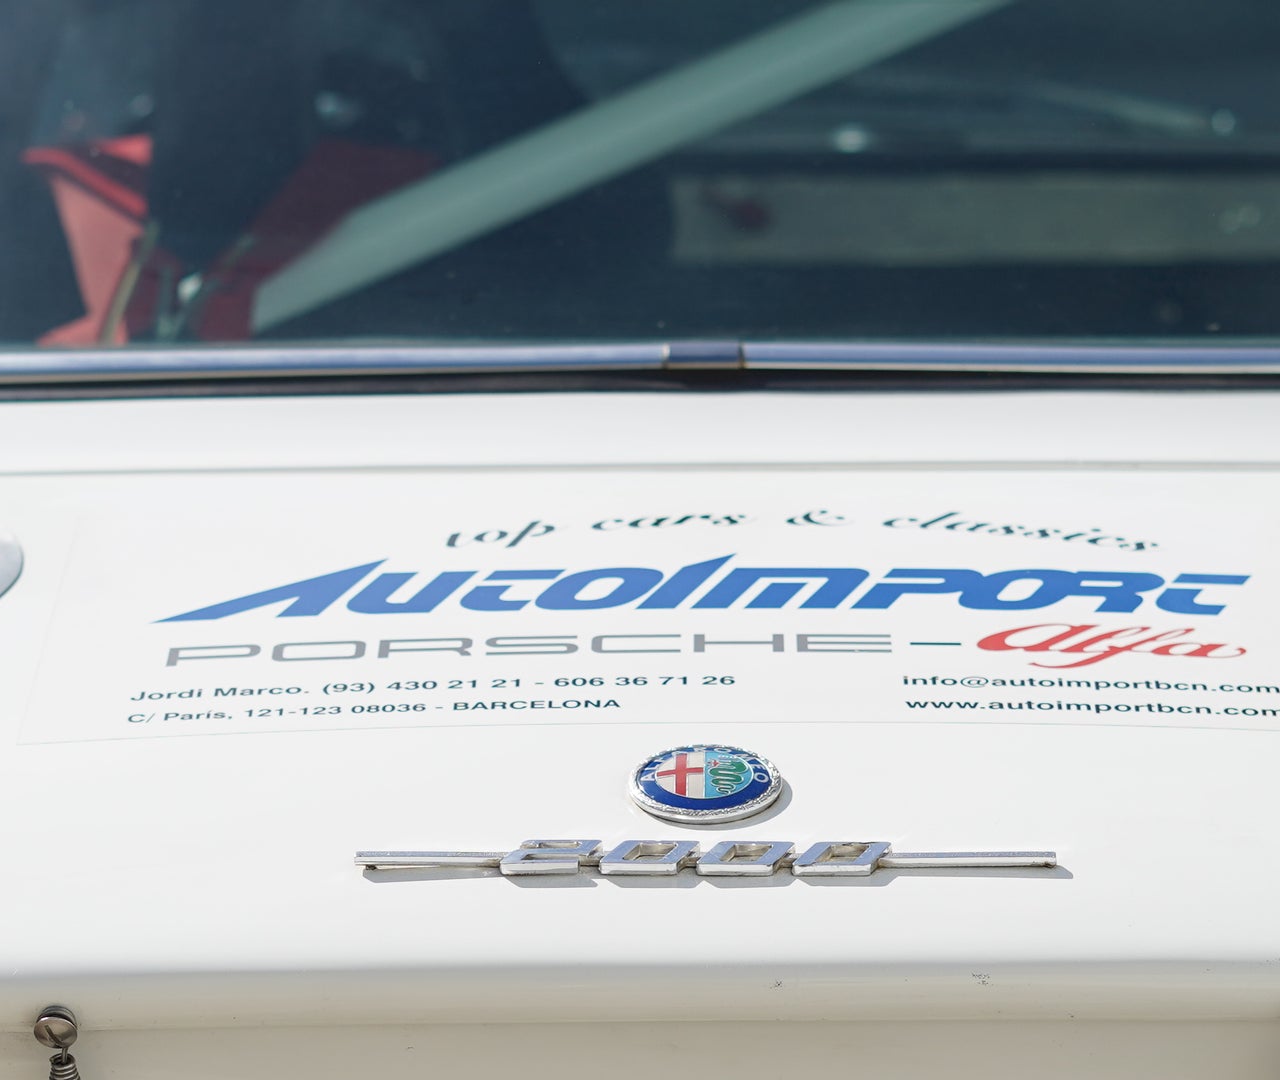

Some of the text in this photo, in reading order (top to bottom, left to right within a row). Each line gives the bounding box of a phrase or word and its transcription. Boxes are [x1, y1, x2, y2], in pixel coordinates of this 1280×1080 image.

[445, 510, 1160, 551] top cars & classics
[165, 633, 892, 667] PORSCHE
[130, 687, 203, 702] Jordi
[213, 685, 309, 698] Marco.
[321, 681, 376, 695] (93)
[386, 680, 438, 691] 430
[447, 679, 478, 690] 21
[490, 678, 521, 689] 21
[554, 676, 605, 688] 606
[615, 676, 649, 687] 36
[658, 675, 689, 686] 71
[701, 675, 737, 687] 26
[127, 712, 157, 724] C/
[244, 706, 343, 718] 121-123
[350, 703, 427, 714] 08036
[452, 699, 621, 712] BARCELONA
[500, 840, 894, 876] 2000
